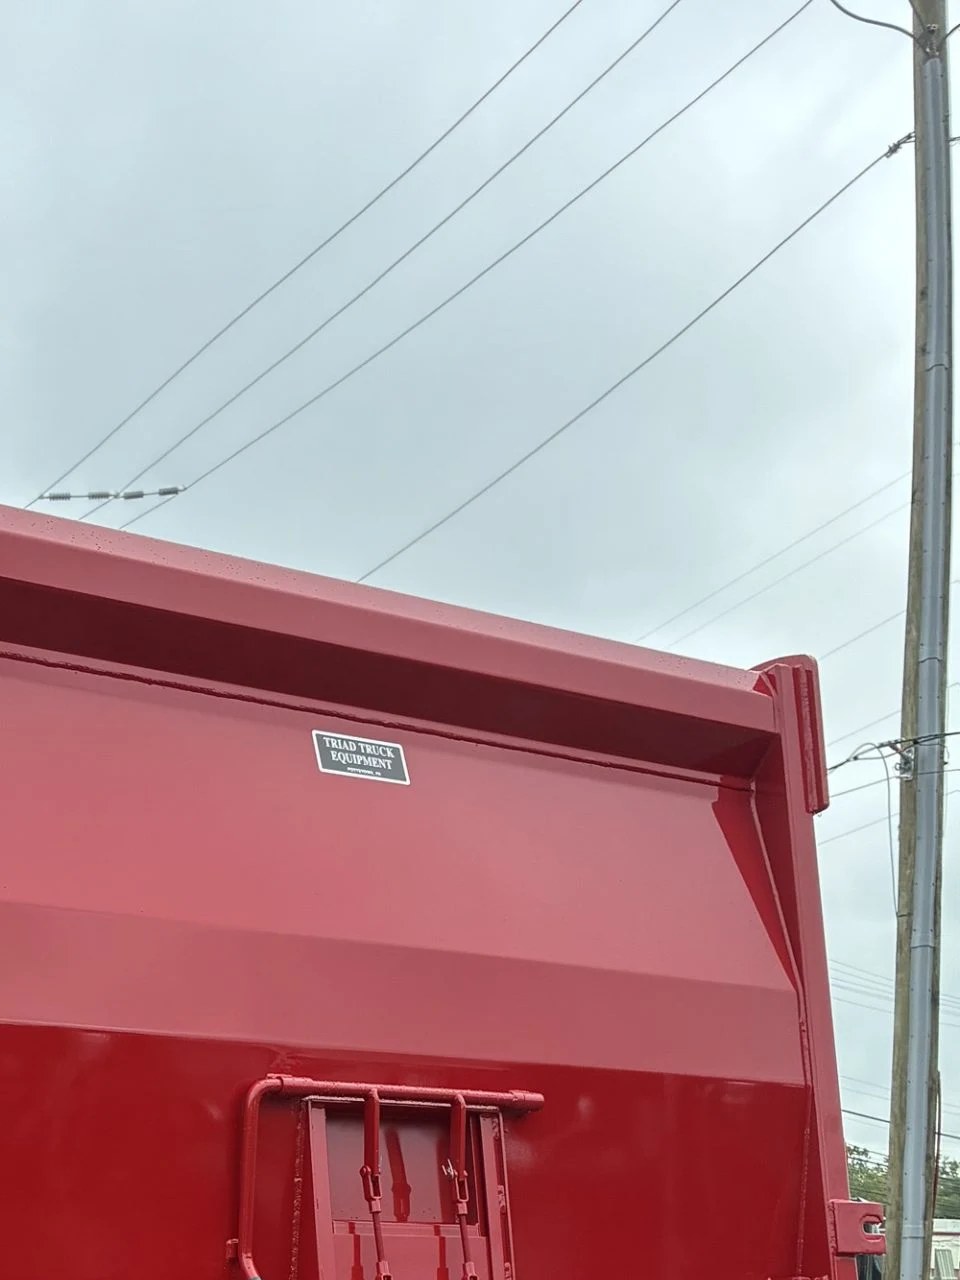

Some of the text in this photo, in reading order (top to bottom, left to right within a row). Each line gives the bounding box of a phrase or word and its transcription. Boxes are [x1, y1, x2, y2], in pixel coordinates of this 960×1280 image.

[322, 736, 395, 759] TRIAD TRUCK
[330, 750, 392, 770] EQUIPMENT
